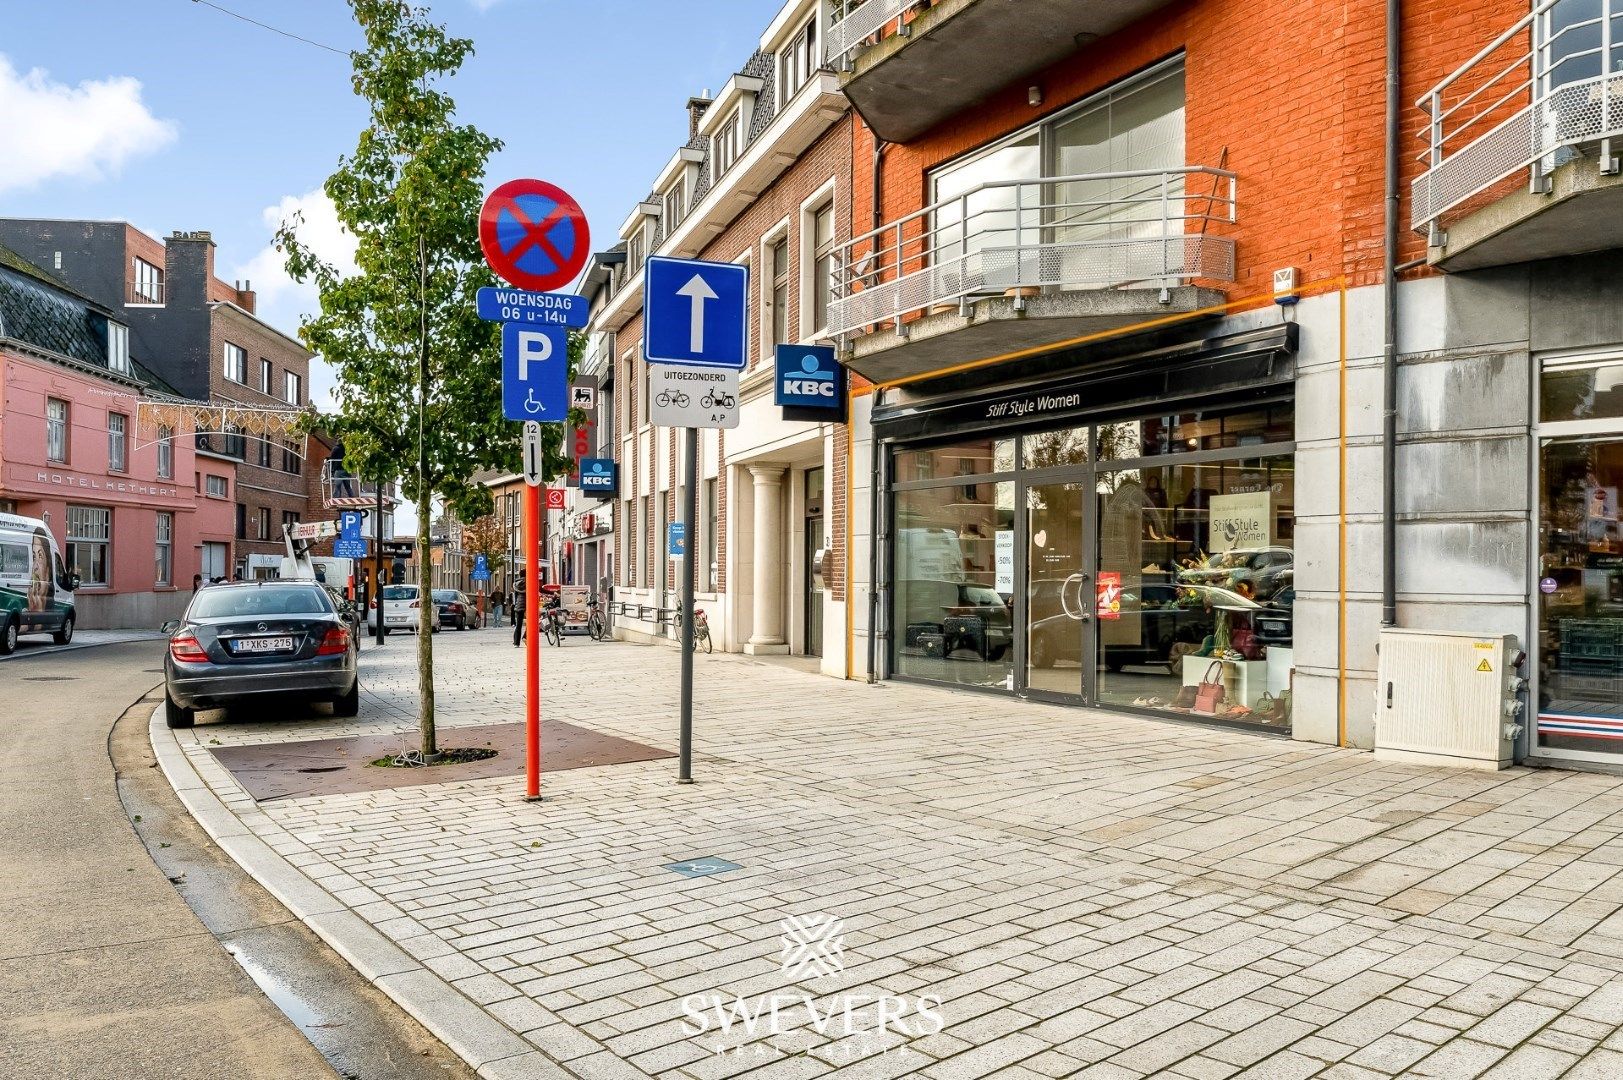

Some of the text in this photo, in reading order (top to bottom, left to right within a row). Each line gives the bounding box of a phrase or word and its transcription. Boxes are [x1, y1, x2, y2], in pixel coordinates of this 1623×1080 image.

[496, 292, 572, 310] WOENSDAG
[502, 307, 520, 319] 06
[518, 330, 553, 381] P
[664, 371, 726, 382] UITGEZONDERD
[783, 380, 834, 397] KBC
[986, 393, 1080, 418] Stiff Style Women
[526, 424, 538, 434] 12
[37, 472, 100, 488] HOTEL
[583, 476, 612, 485] KBC
[345, 515, 356, 530] P
[1235, 518, 1258, 533] Style
[477, 556, 485, 565] P
